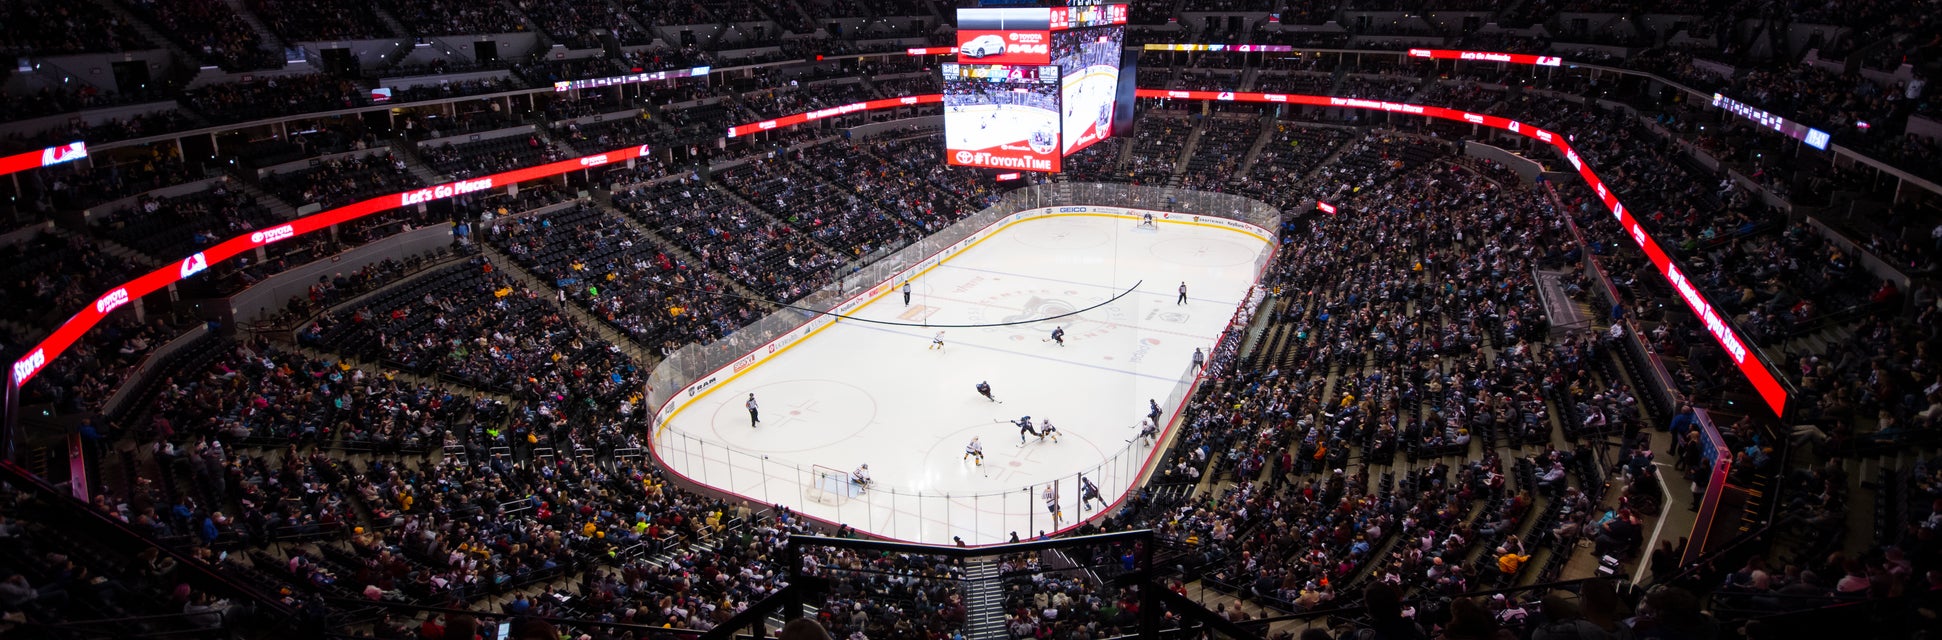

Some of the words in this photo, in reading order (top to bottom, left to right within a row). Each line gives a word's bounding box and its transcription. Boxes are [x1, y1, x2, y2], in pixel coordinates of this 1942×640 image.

[401, 188, 433, 206] Let's
[434, 185, 453, 199] Go
[454, 178, 492, 195] Places
[264, 225, 293, 239] TOYOTA
[103, 287, 128, 306] TOYOTA
[1703, 303, 1725, 339] Toyota
[1722, 326, 1746, 364] Stores
[14, 347, 45, 384] Stores
[696, 377, 717, 391] RAM
